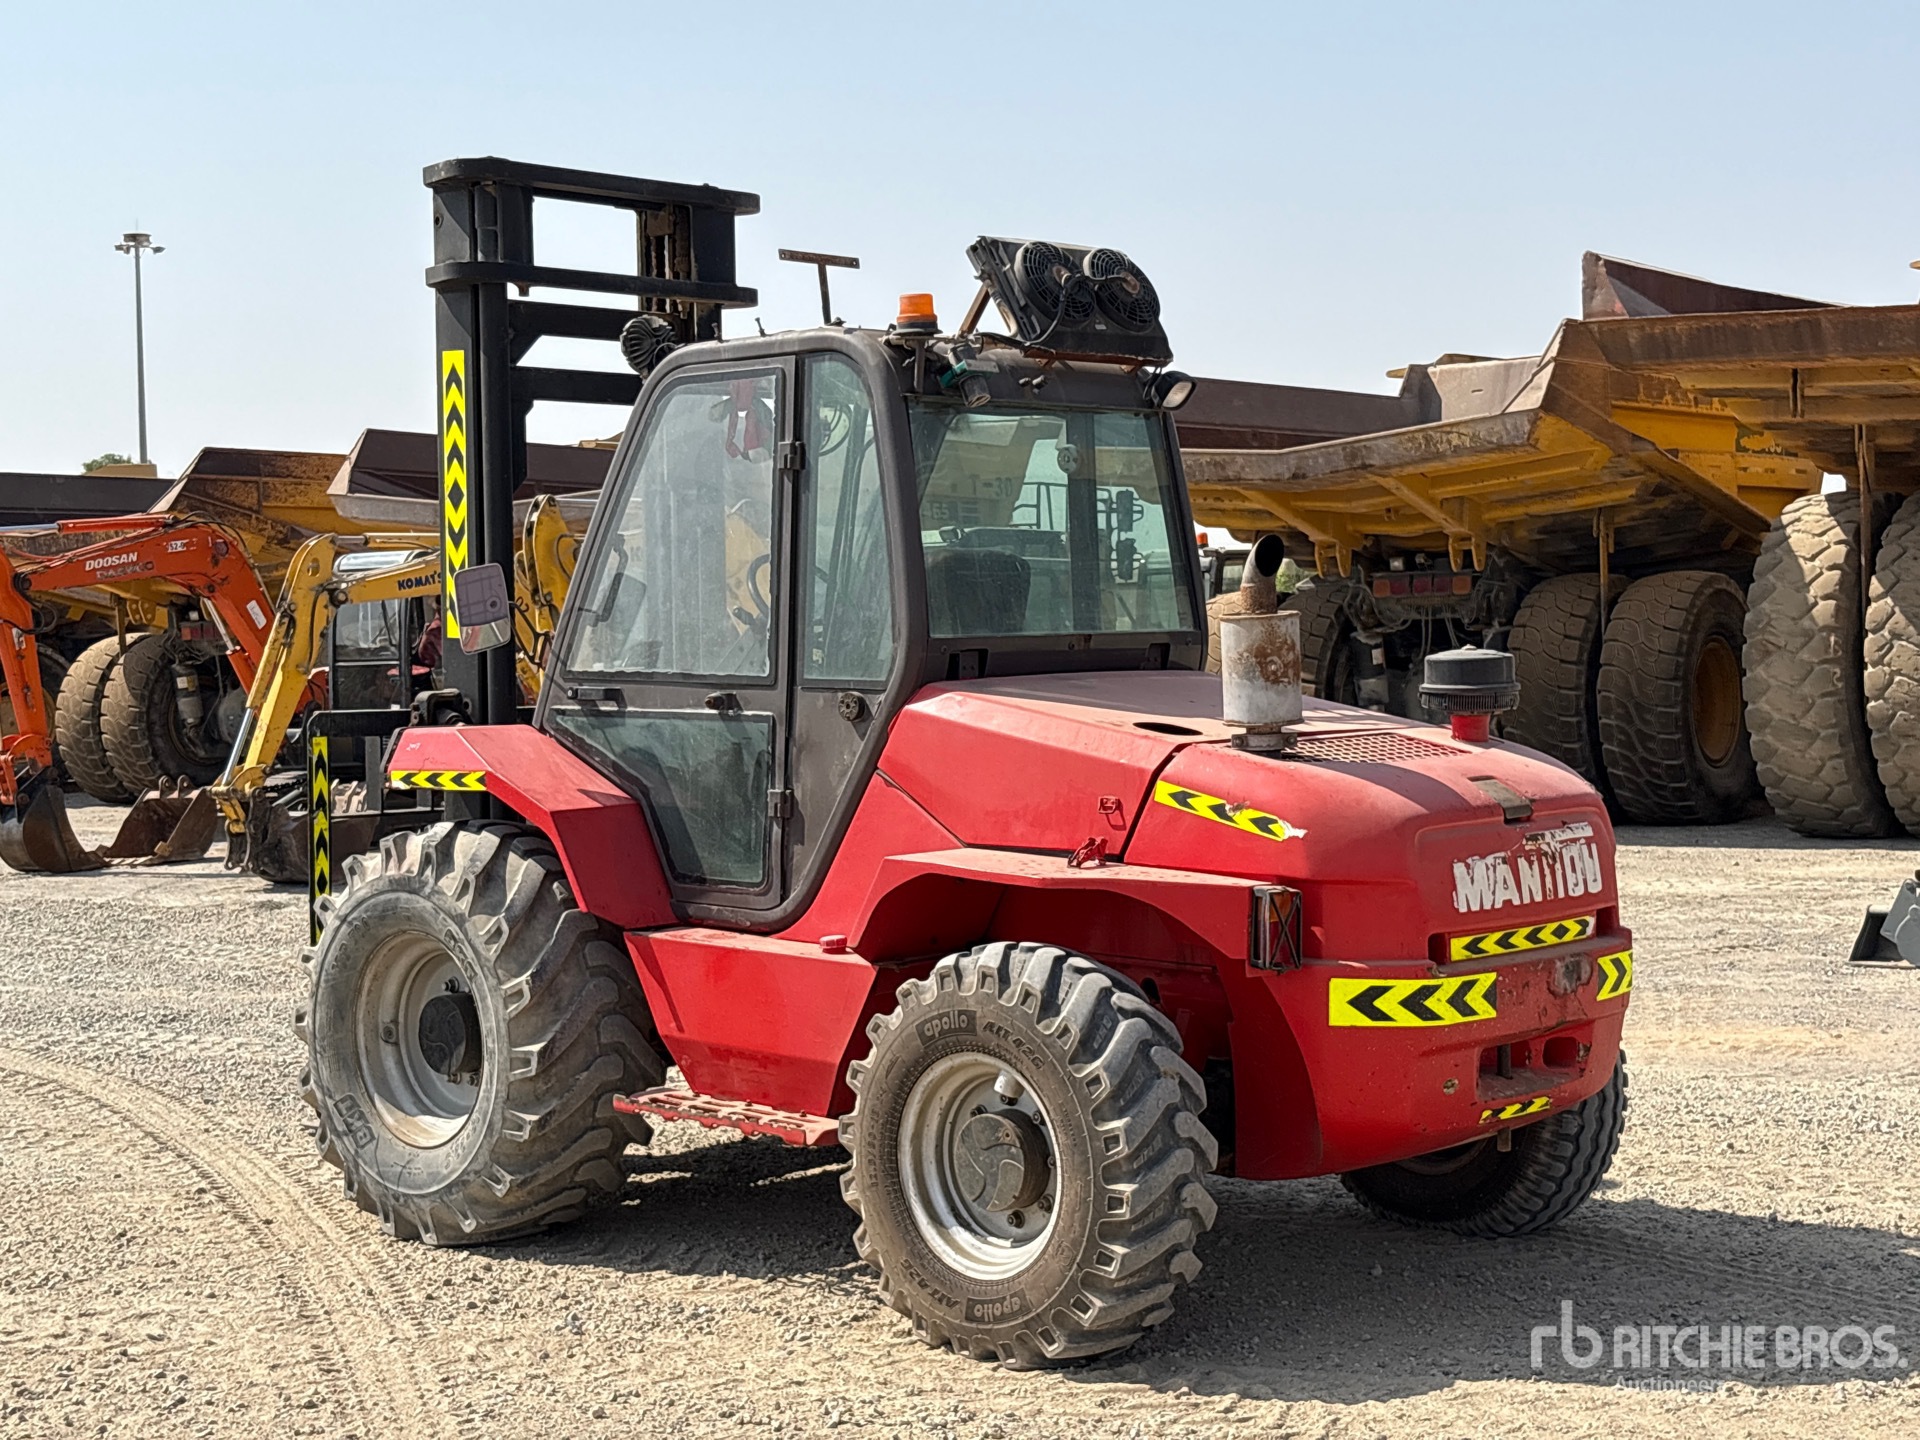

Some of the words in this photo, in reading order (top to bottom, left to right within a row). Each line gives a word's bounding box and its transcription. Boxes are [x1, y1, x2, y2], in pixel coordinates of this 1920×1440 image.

[85, 552, 138, 571] DOOSAN
[1453, 822, 1602, 913] MANITOU
[924, 1010, 968, 1038] apollo
[973, 1295, 1021, 1322] apollo
